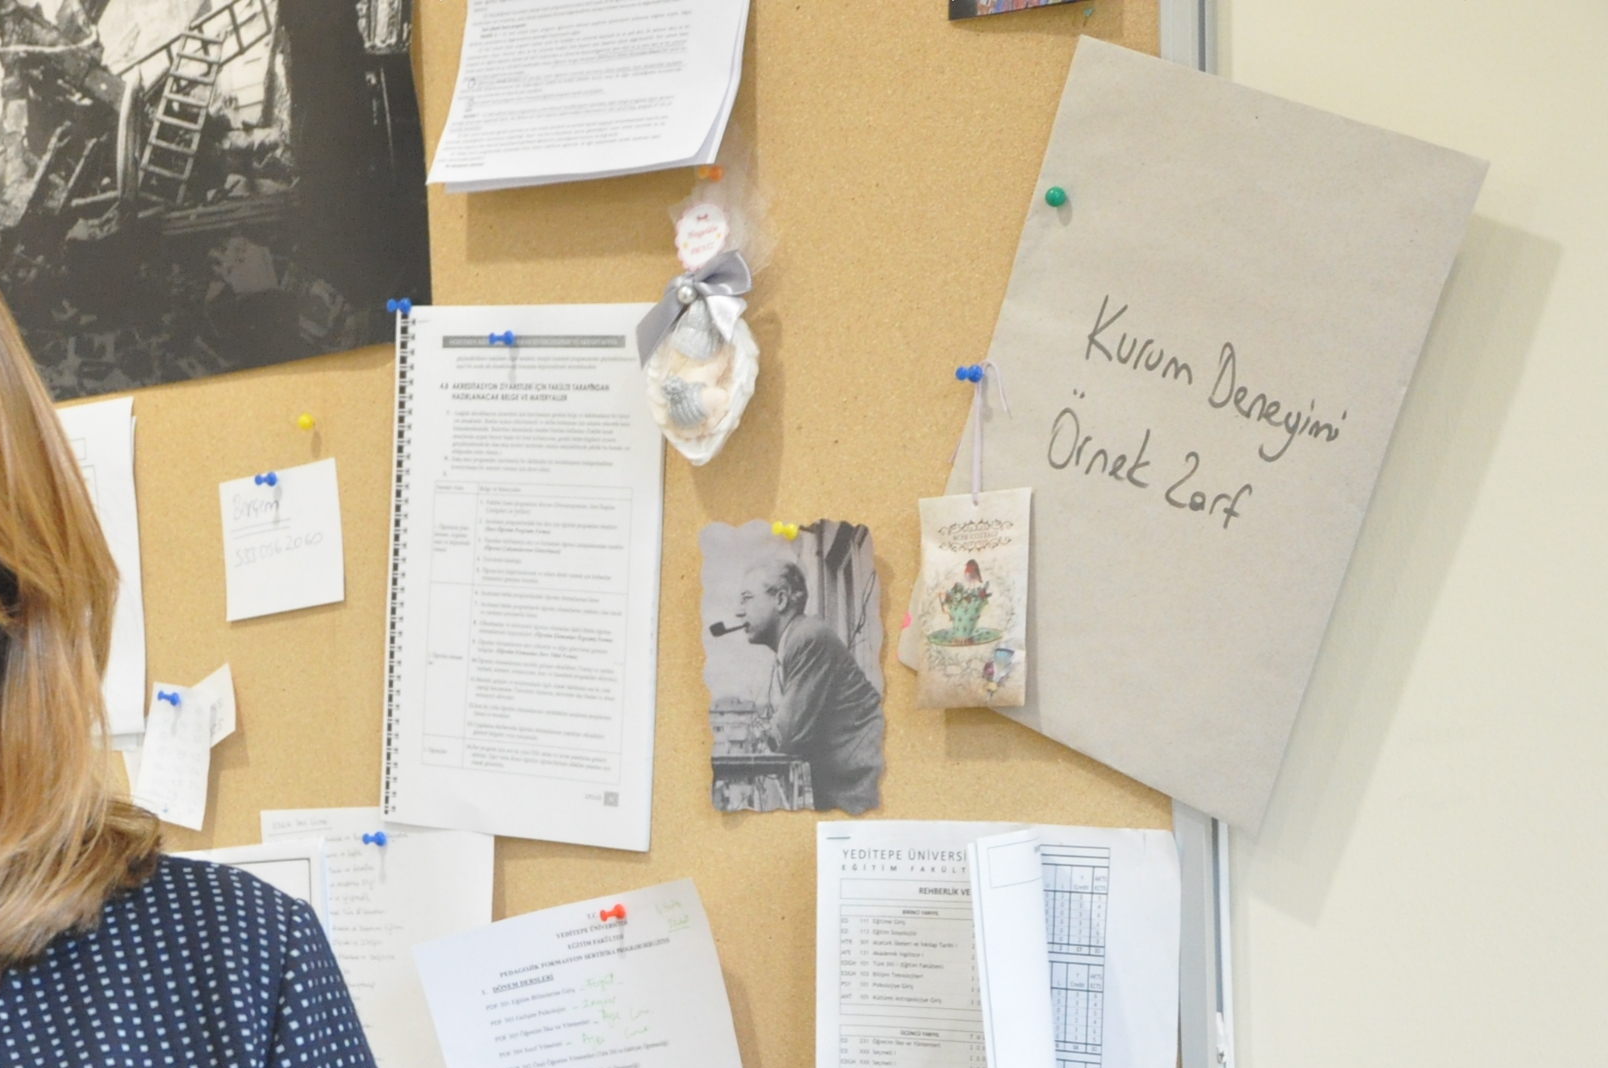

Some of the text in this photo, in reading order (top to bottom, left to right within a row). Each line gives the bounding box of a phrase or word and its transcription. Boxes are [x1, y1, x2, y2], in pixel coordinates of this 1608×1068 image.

[1085, 294, 1193, 385] Kurum
[842, 847, 968, 861] YEDİTEPE ÜNİVERSİ
